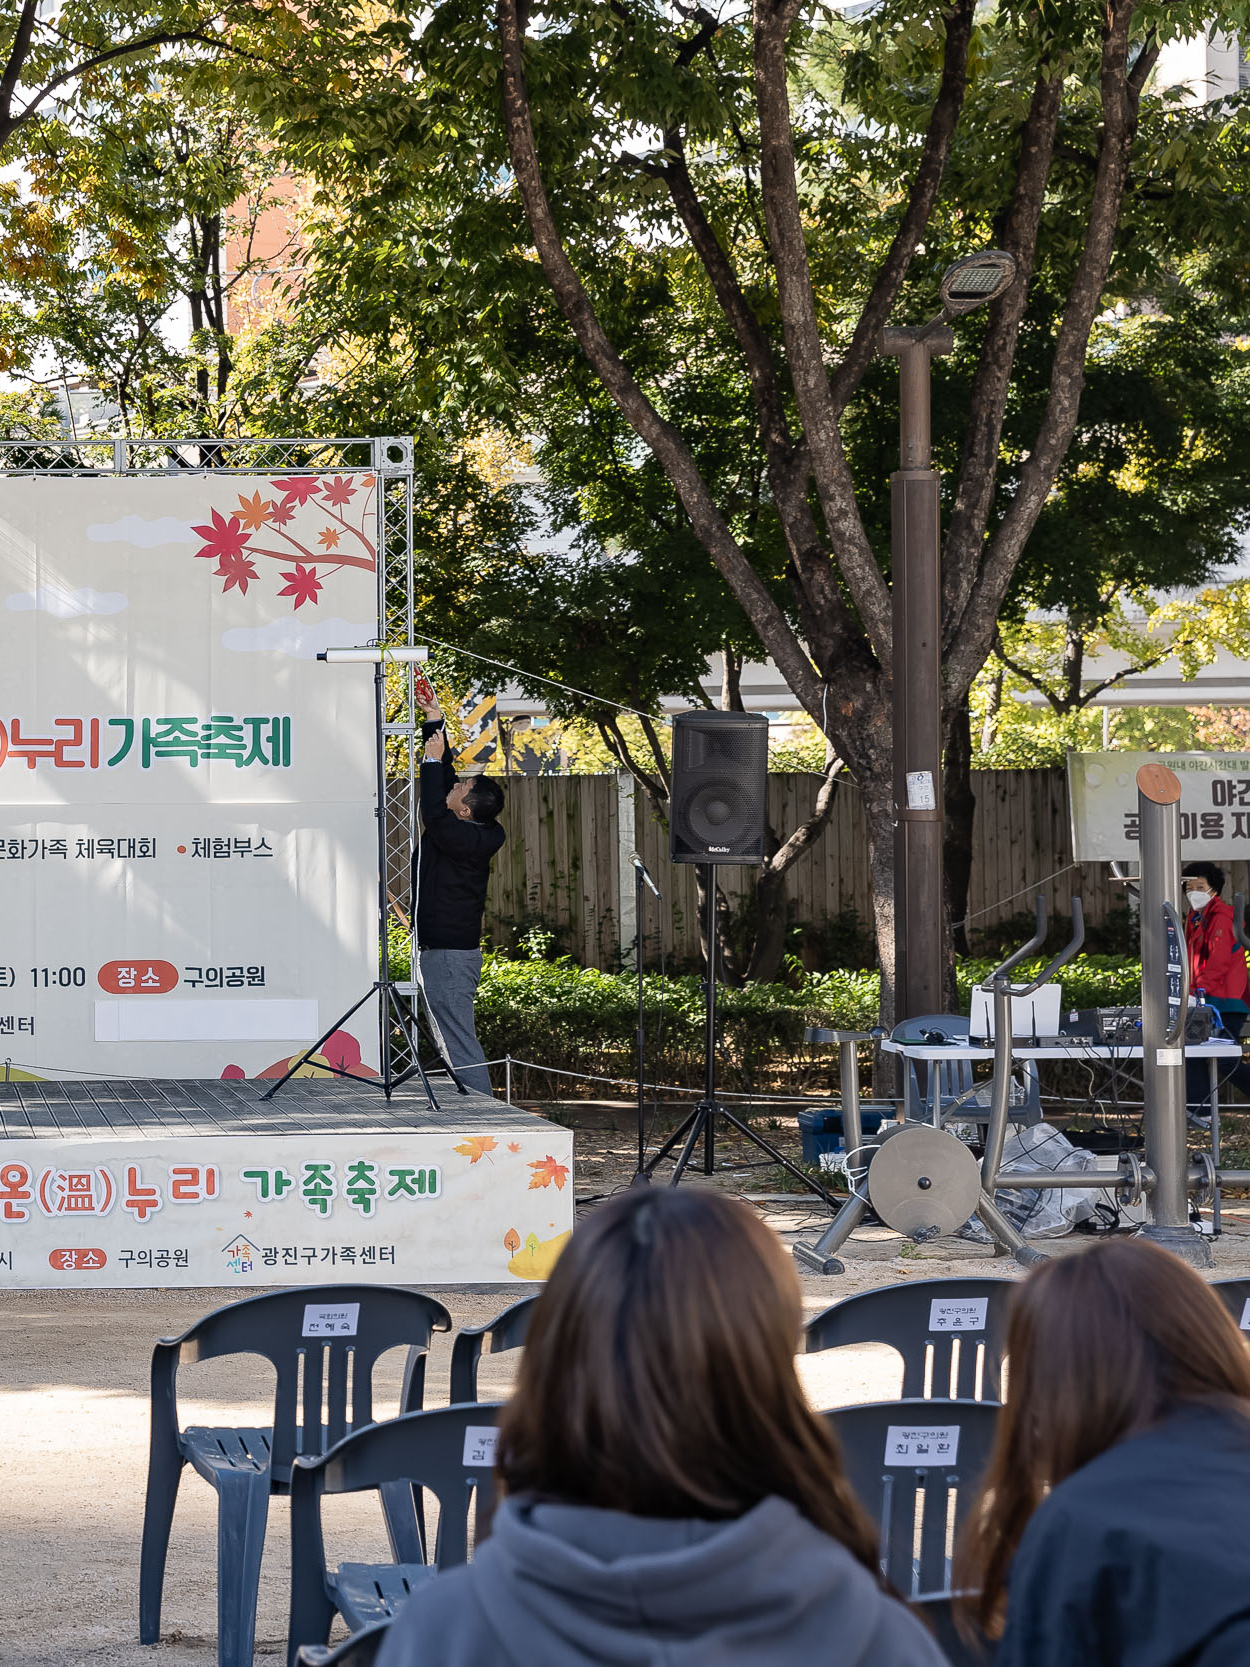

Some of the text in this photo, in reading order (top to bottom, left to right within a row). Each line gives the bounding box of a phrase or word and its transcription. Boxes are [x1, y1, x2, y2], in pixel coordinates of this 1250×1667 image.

[107, 716, 291, 769] 가족축제
[75, 837, 157, 859] 체육대회
[191, 837, 274, 859] 체험부스
[30, 966, 86, 988] 11:00
[183, 966, 266, 988] 구의공원
[243, 1161, 437, 1214] 가족축제
[118, 1249, 189, 1269] 구의공원
[261, 1245, 396, 1265] 광진구가족센터
